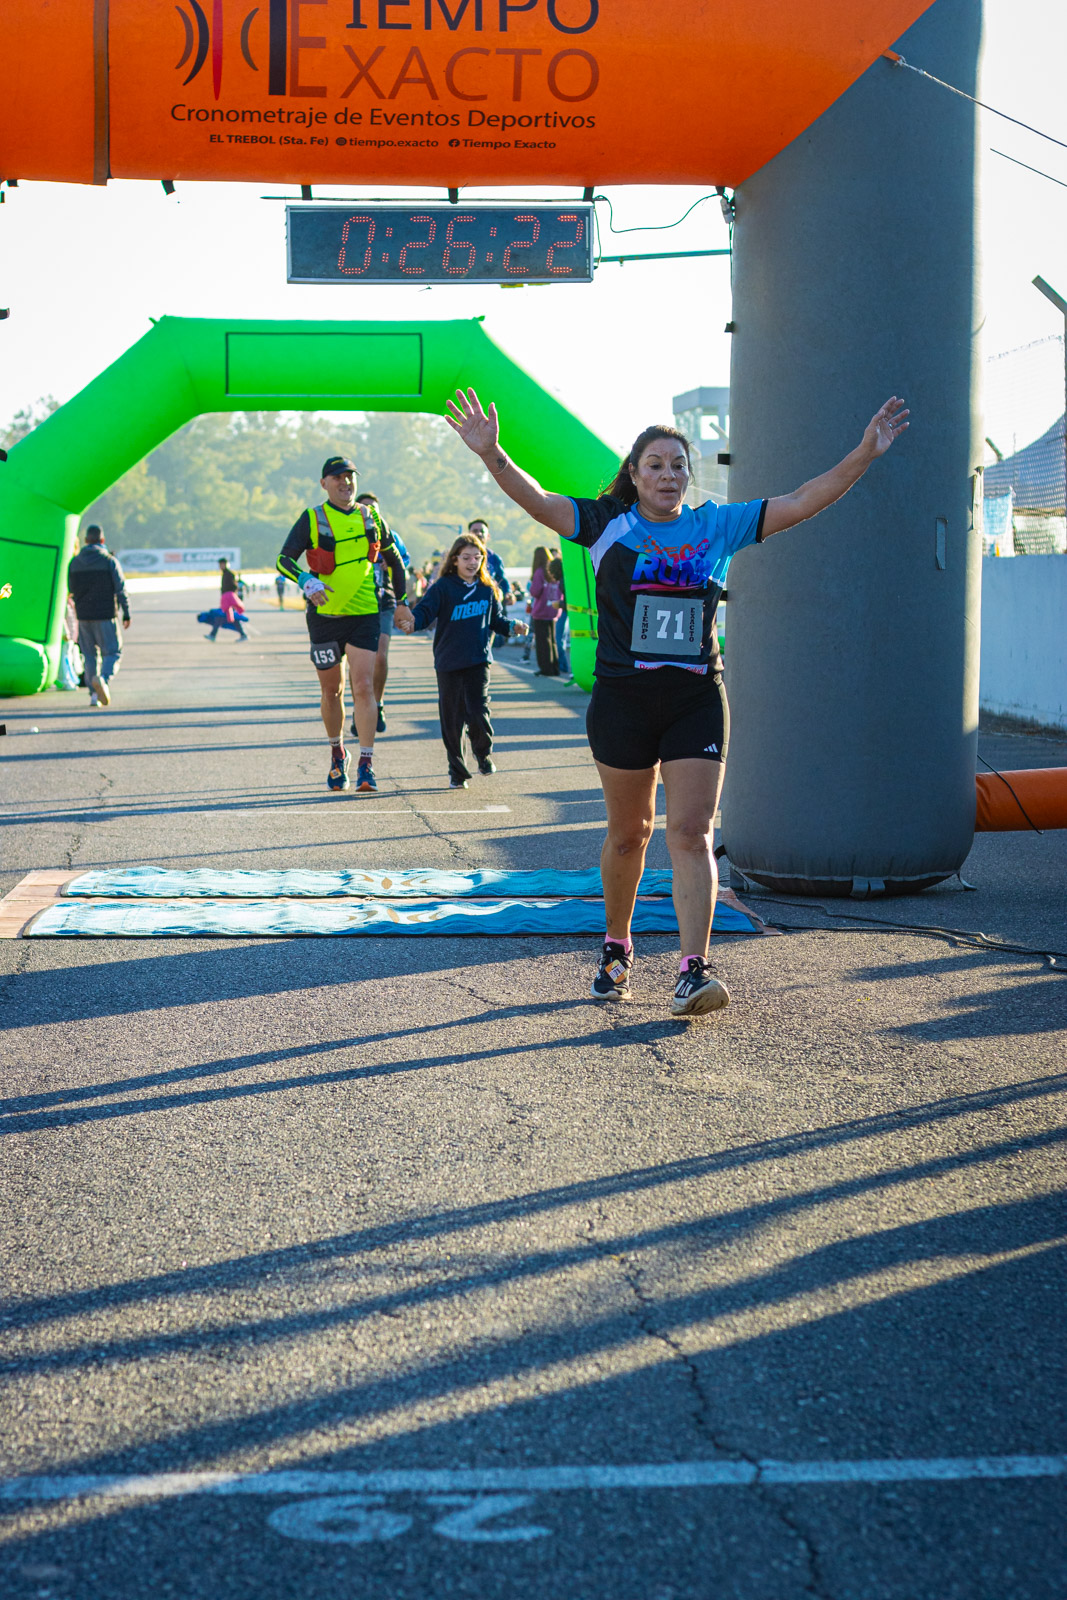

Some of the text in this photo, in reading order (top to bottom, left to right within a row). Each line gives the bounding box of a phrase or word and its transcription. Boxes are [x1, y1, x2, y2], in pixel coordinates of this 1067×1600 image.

[171, 103, 596, 131] Cronometraje de Eventos Deportivos
[209, 134, 329, 146] EL TREBOL (Sta. Fe)
[349, 137, 439, 148] tiempo.exacto
[463, 139, 556, 150] Tiempo Exacto
[338, 215, 584, 274] 0:26:22
[641, 605, 650, 640] TIEMPO
[656, 609, 684, 640] 71
[313, 648, 336, 665] 153
